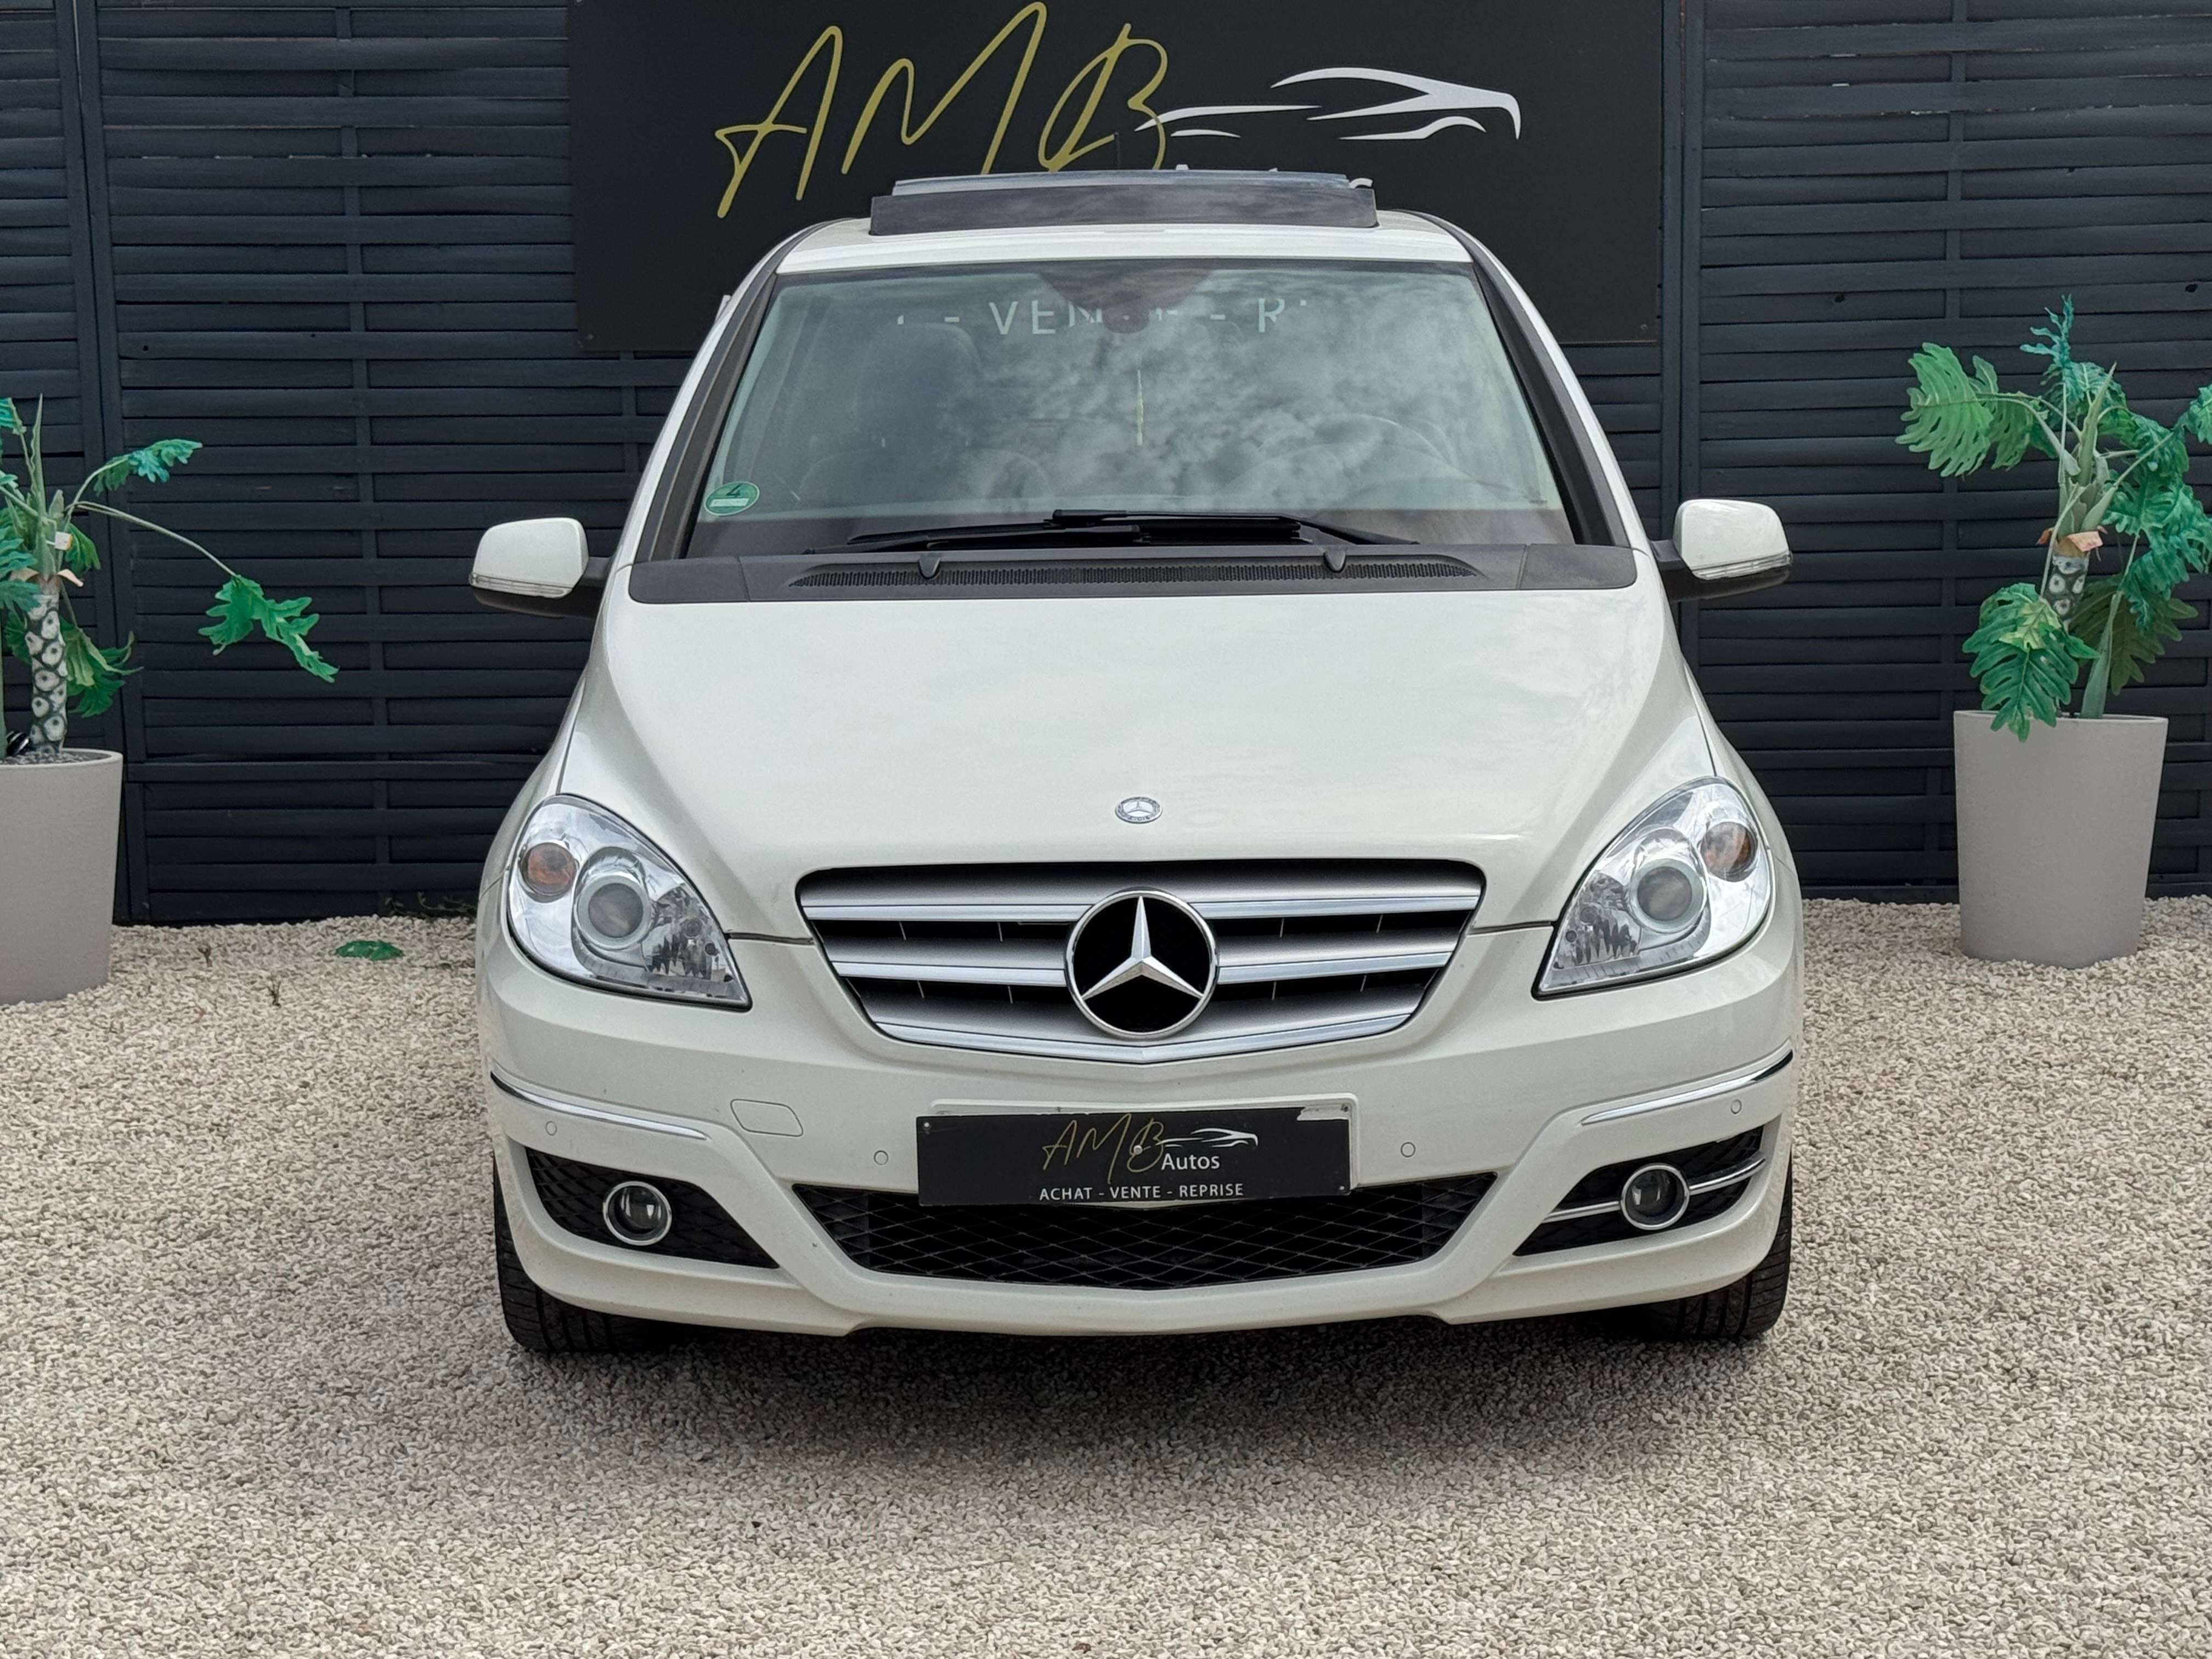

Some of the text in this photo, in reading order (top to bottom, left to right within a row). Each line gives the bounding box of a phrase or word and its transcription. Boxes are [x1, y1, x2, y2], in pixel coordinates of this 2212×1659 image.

[715, 2, 1167, 218] AMB
[725, 483, 742, 498] 4
[1042, 1113, 1221, 1184] AMB Autos
[1039, 1187, 1093, 1201] ACHAT
[1109, 1186, 1161, 1199] VENTE
[1179, 1183, 1244, 1198] REPRISE
